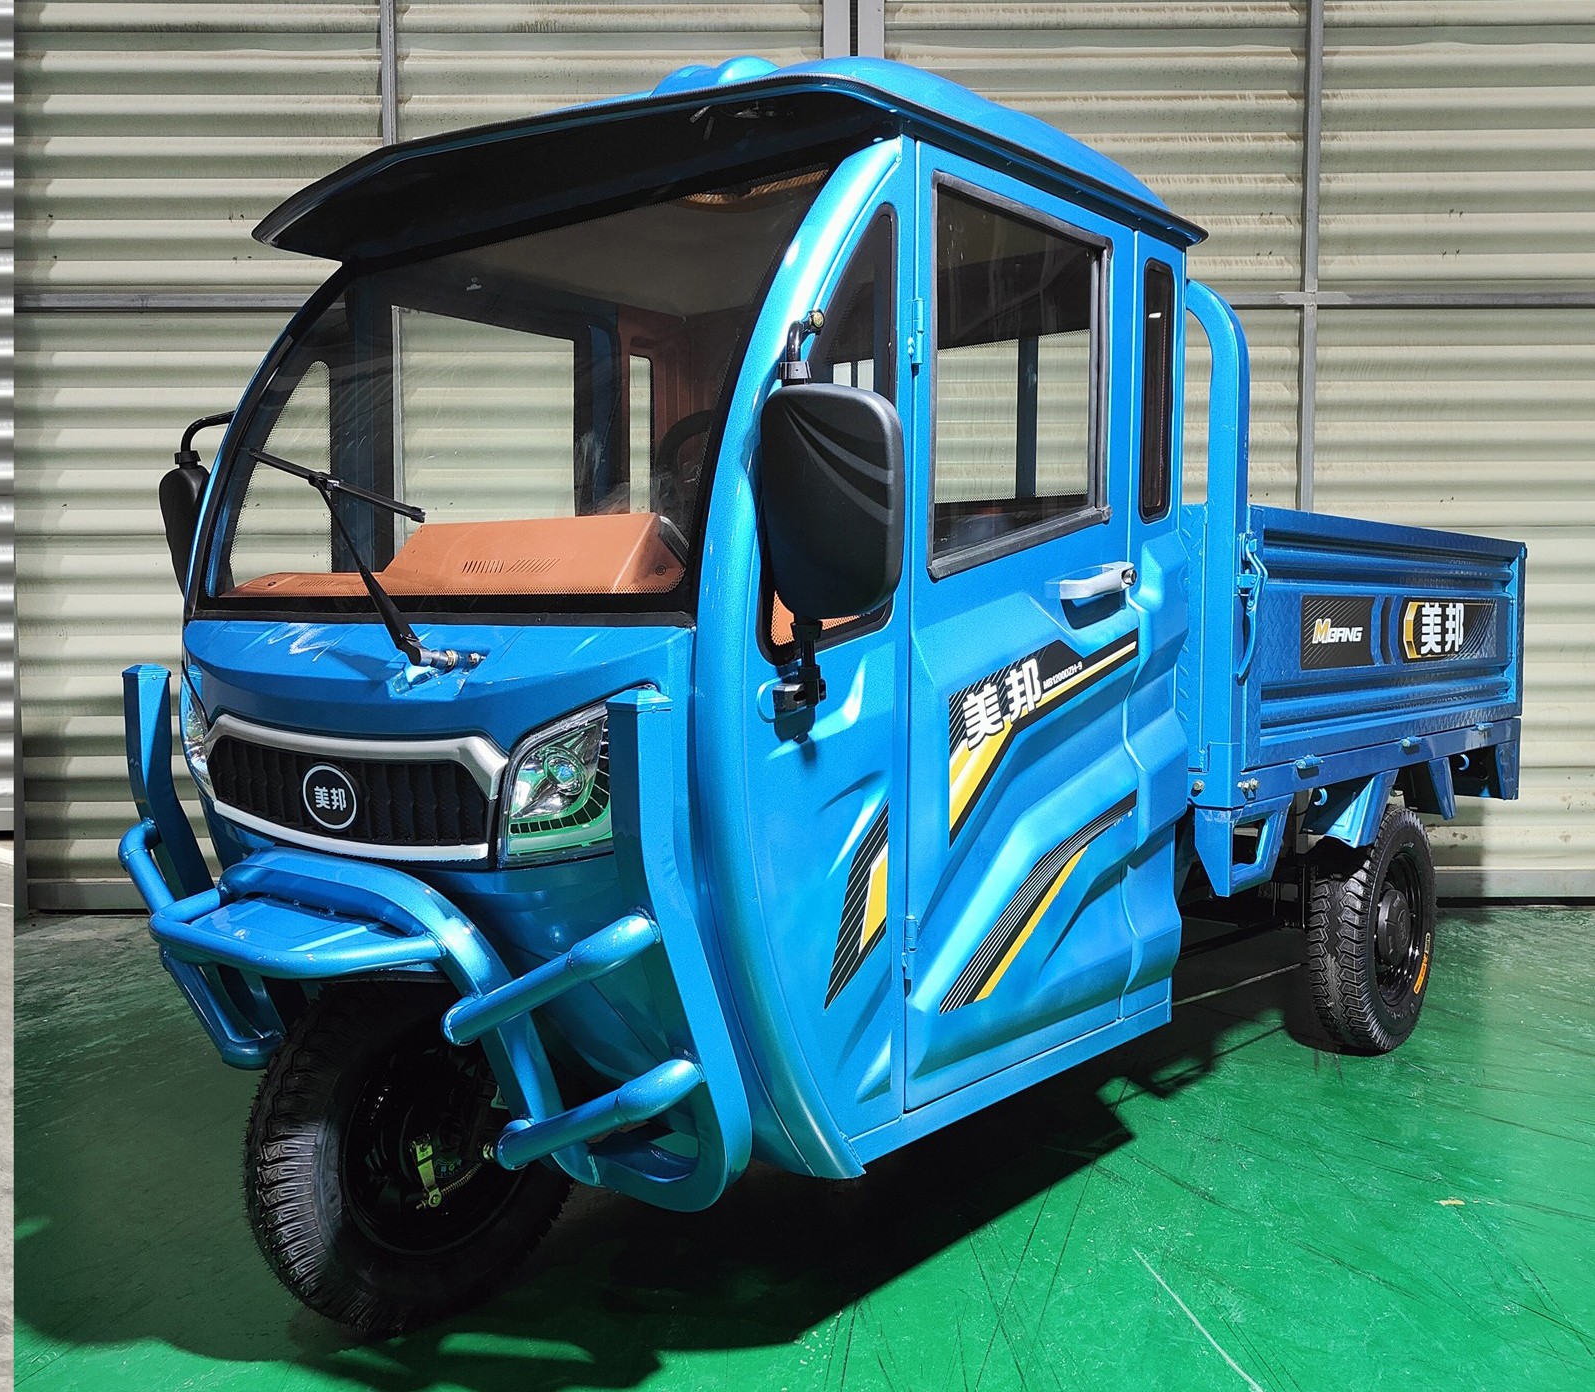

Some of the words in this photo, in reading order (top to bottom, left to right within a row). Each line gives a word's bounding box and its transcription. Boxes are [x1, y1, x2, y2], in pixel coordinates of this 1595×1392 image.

[1420, 602, 1465, 655] 美邦
[962, 658, 1042, 749] 美邦
[313, 785, 347, 811] 美邦
